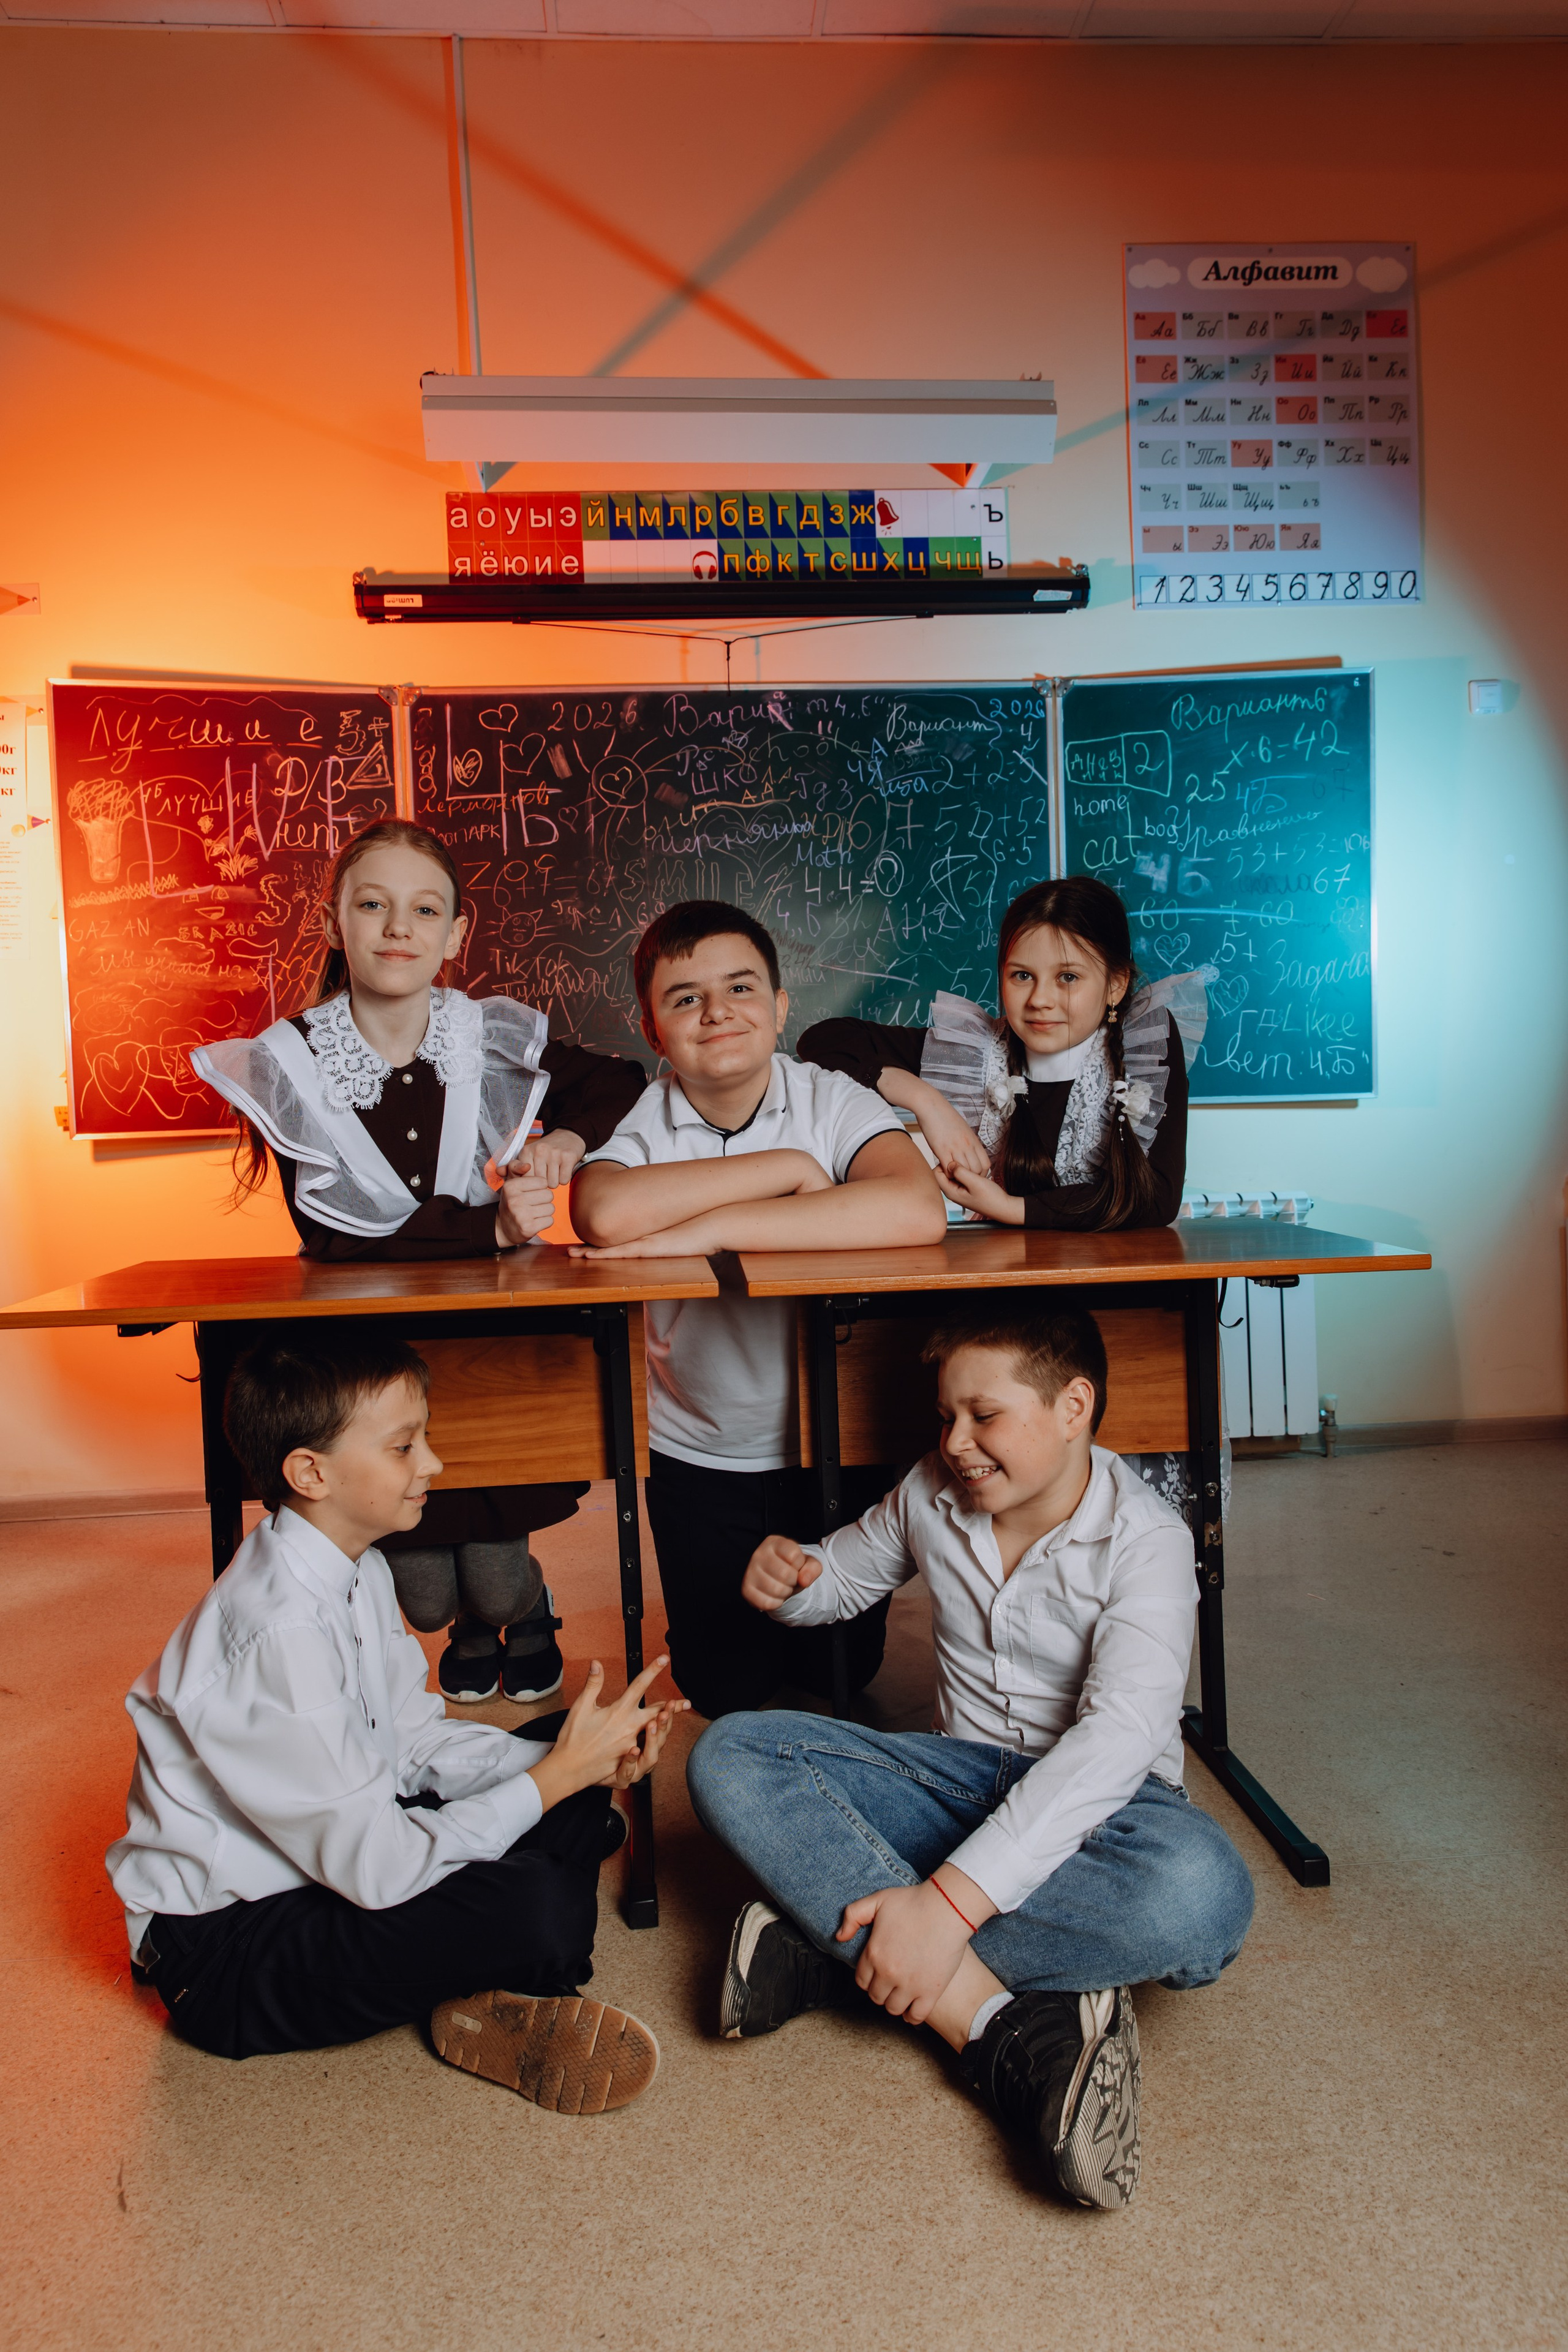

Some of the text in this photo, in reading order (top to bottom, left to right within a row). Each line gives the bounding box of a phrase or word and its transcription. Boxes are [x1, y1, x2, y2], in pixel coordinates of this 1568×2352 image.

[1202, 260, 1338, 286] Алфавит
[1150, 320, 1174, 337] Аа
[989, 698, 1046, 719] 2026
